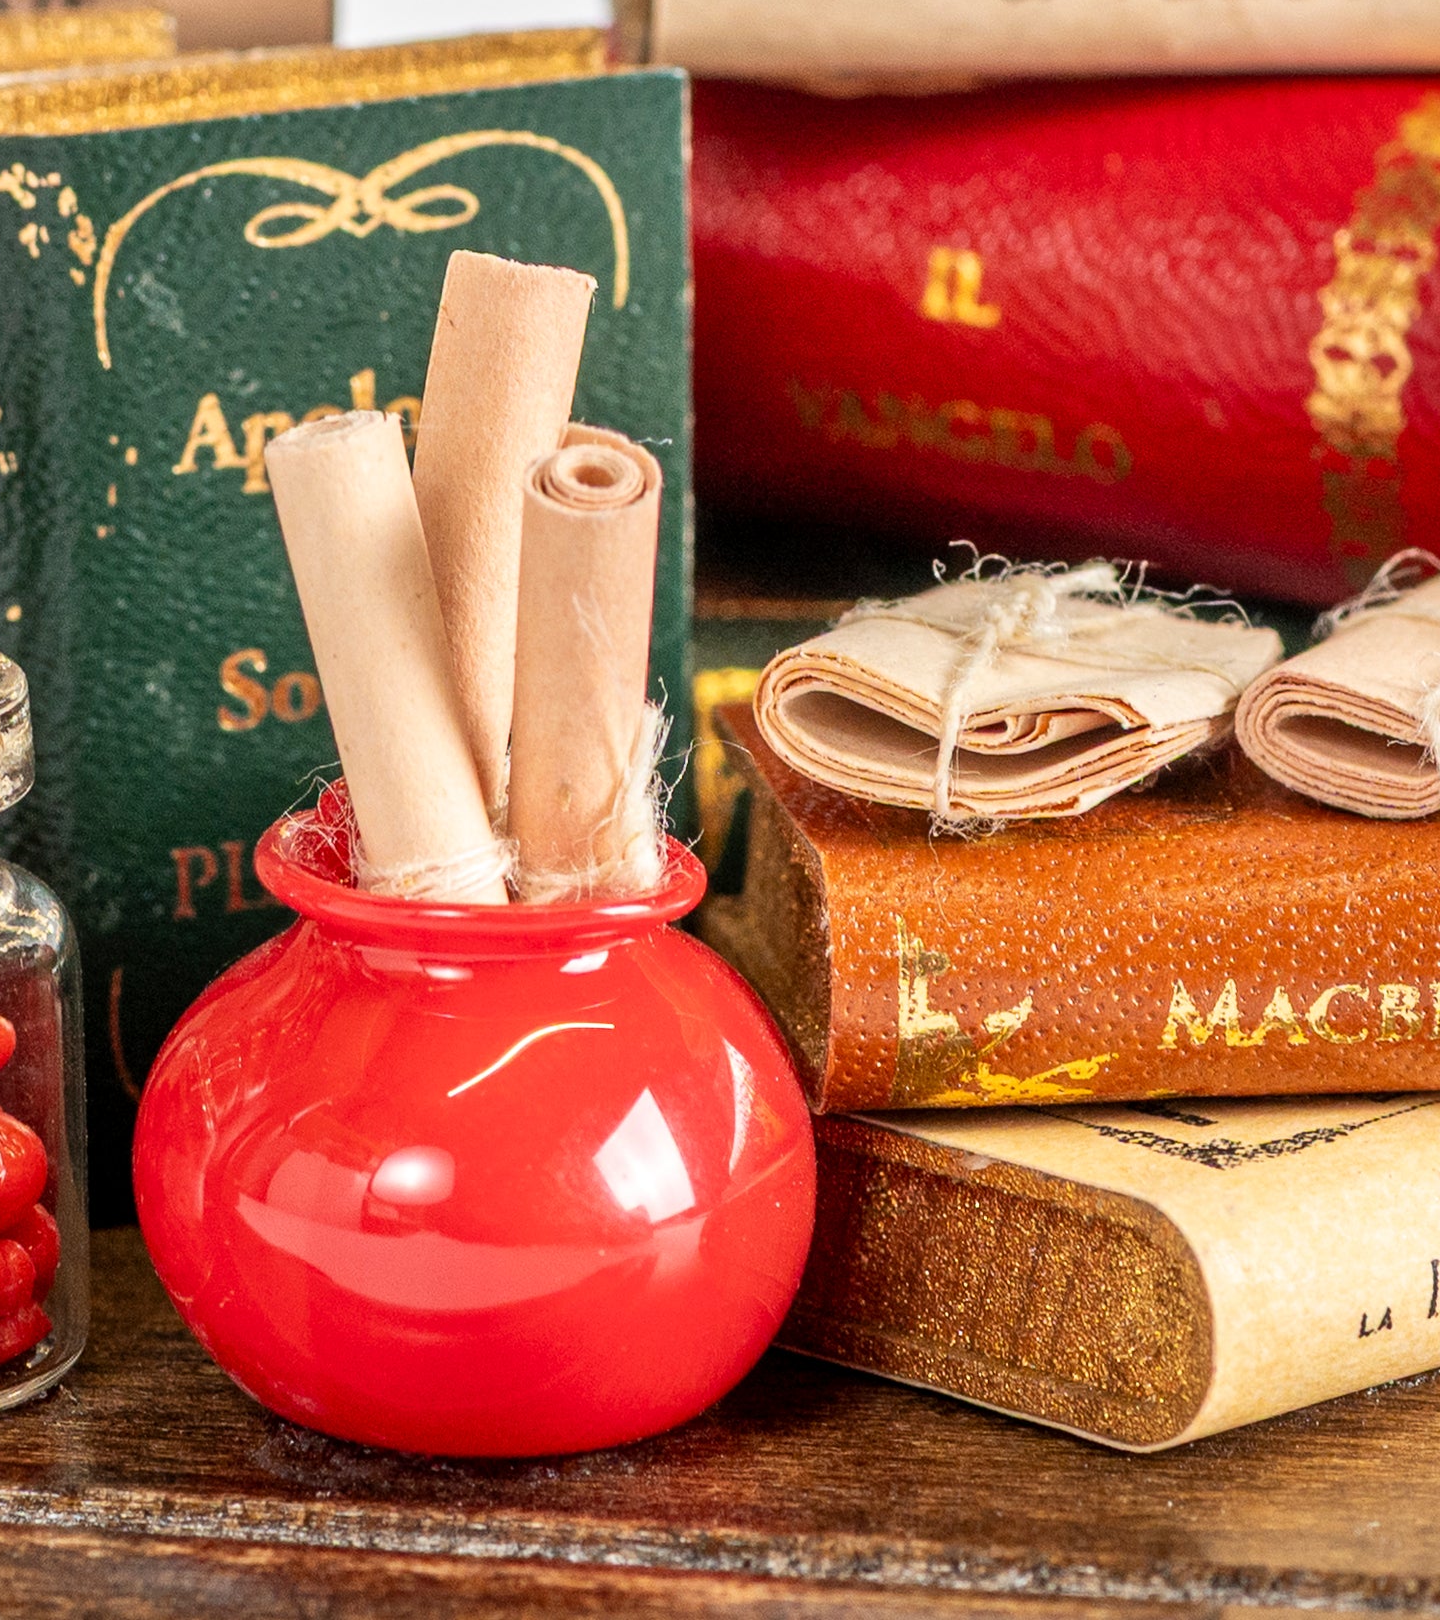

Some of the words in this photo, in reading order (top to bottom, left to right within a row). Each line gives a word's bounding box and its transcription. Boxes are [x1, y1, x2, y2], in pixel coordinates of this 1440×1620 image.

[920, 244, 1001, 330] IL
[217, 647, 323, 732] So
[170, 840, 270, 922] PL
[1358, 1306, 1394, 1339] LA
